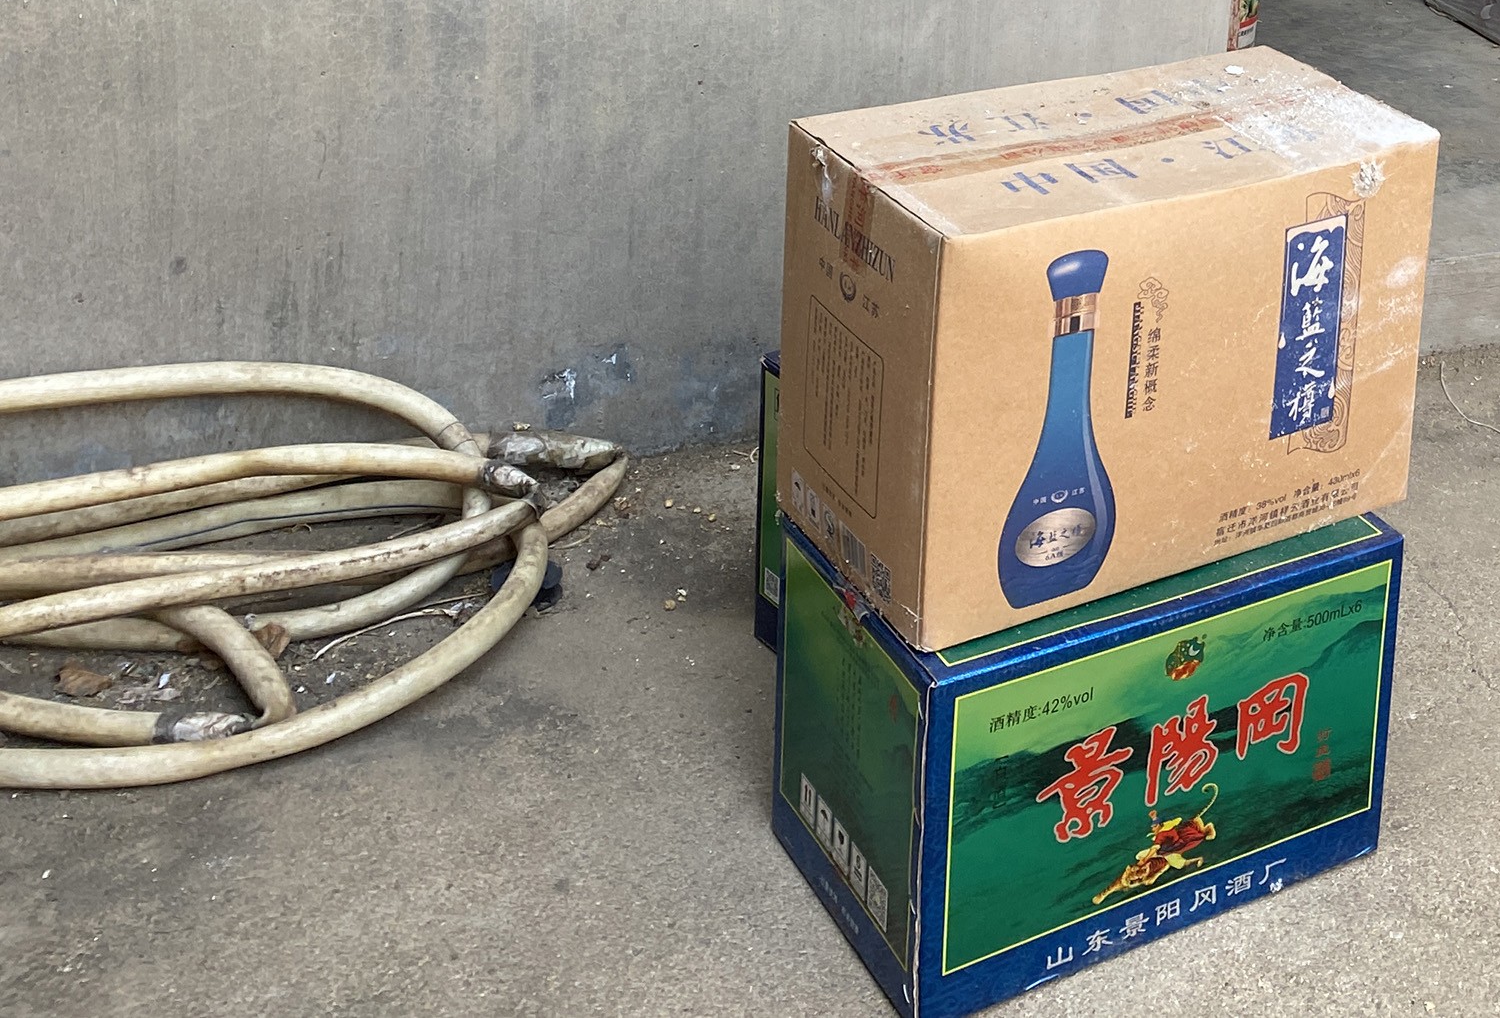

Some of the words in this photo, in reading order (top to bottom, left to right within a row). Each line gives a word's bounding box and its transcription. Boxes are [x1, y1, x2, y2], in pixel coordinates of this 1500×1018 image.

[1142, 327, 1161, 412] 绵柔新概念
[989, 686, 1094, 733] 酒精度:42%vol
